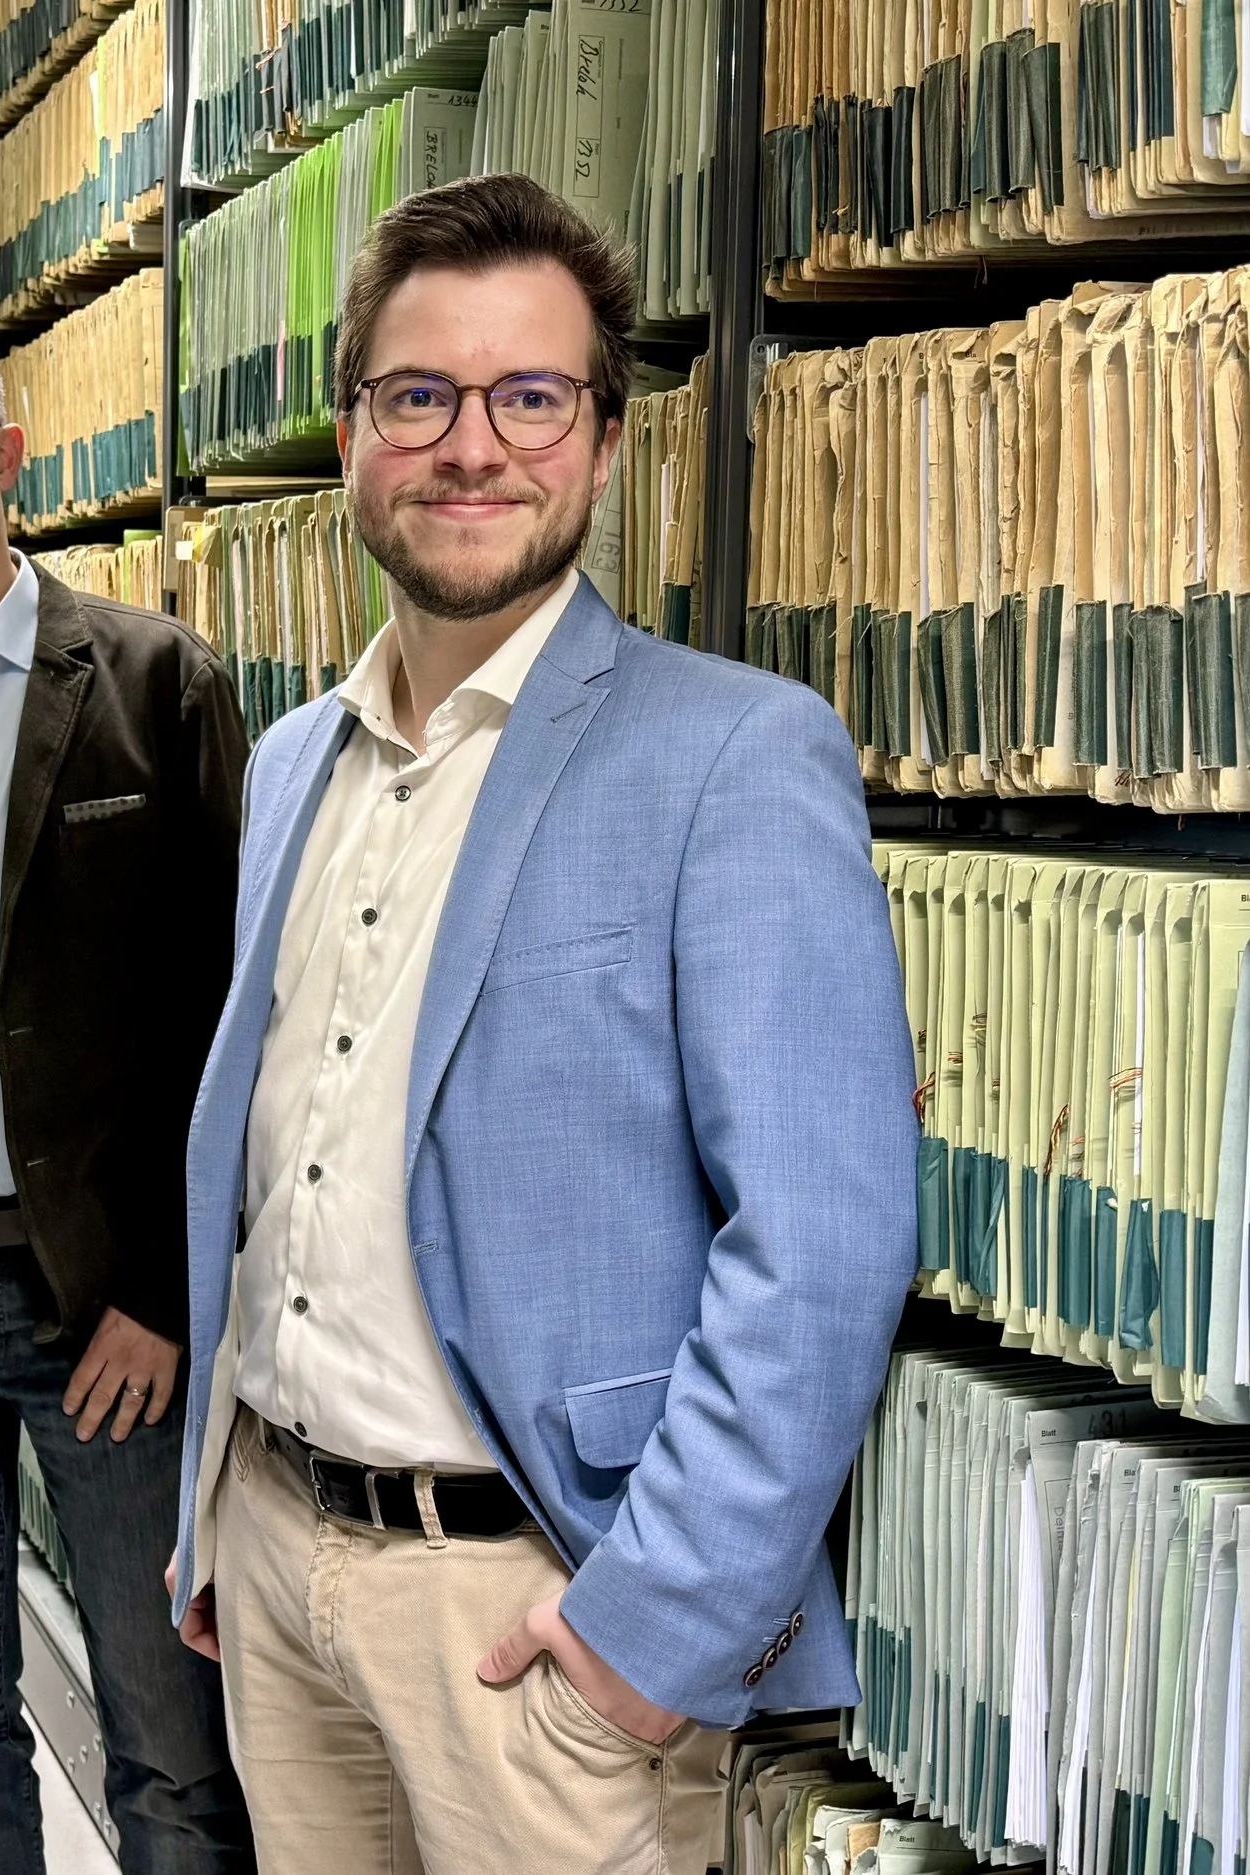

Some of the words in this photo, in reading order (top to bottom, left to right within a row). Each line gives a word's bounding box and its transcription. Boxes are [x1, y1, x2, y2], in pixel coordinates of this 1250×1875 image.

[1041, 1429, 1057, 1438] Blatt
[1124, 1469, 1136, 1477] Bla
[899, 1835, 916, 1843] Blatt
